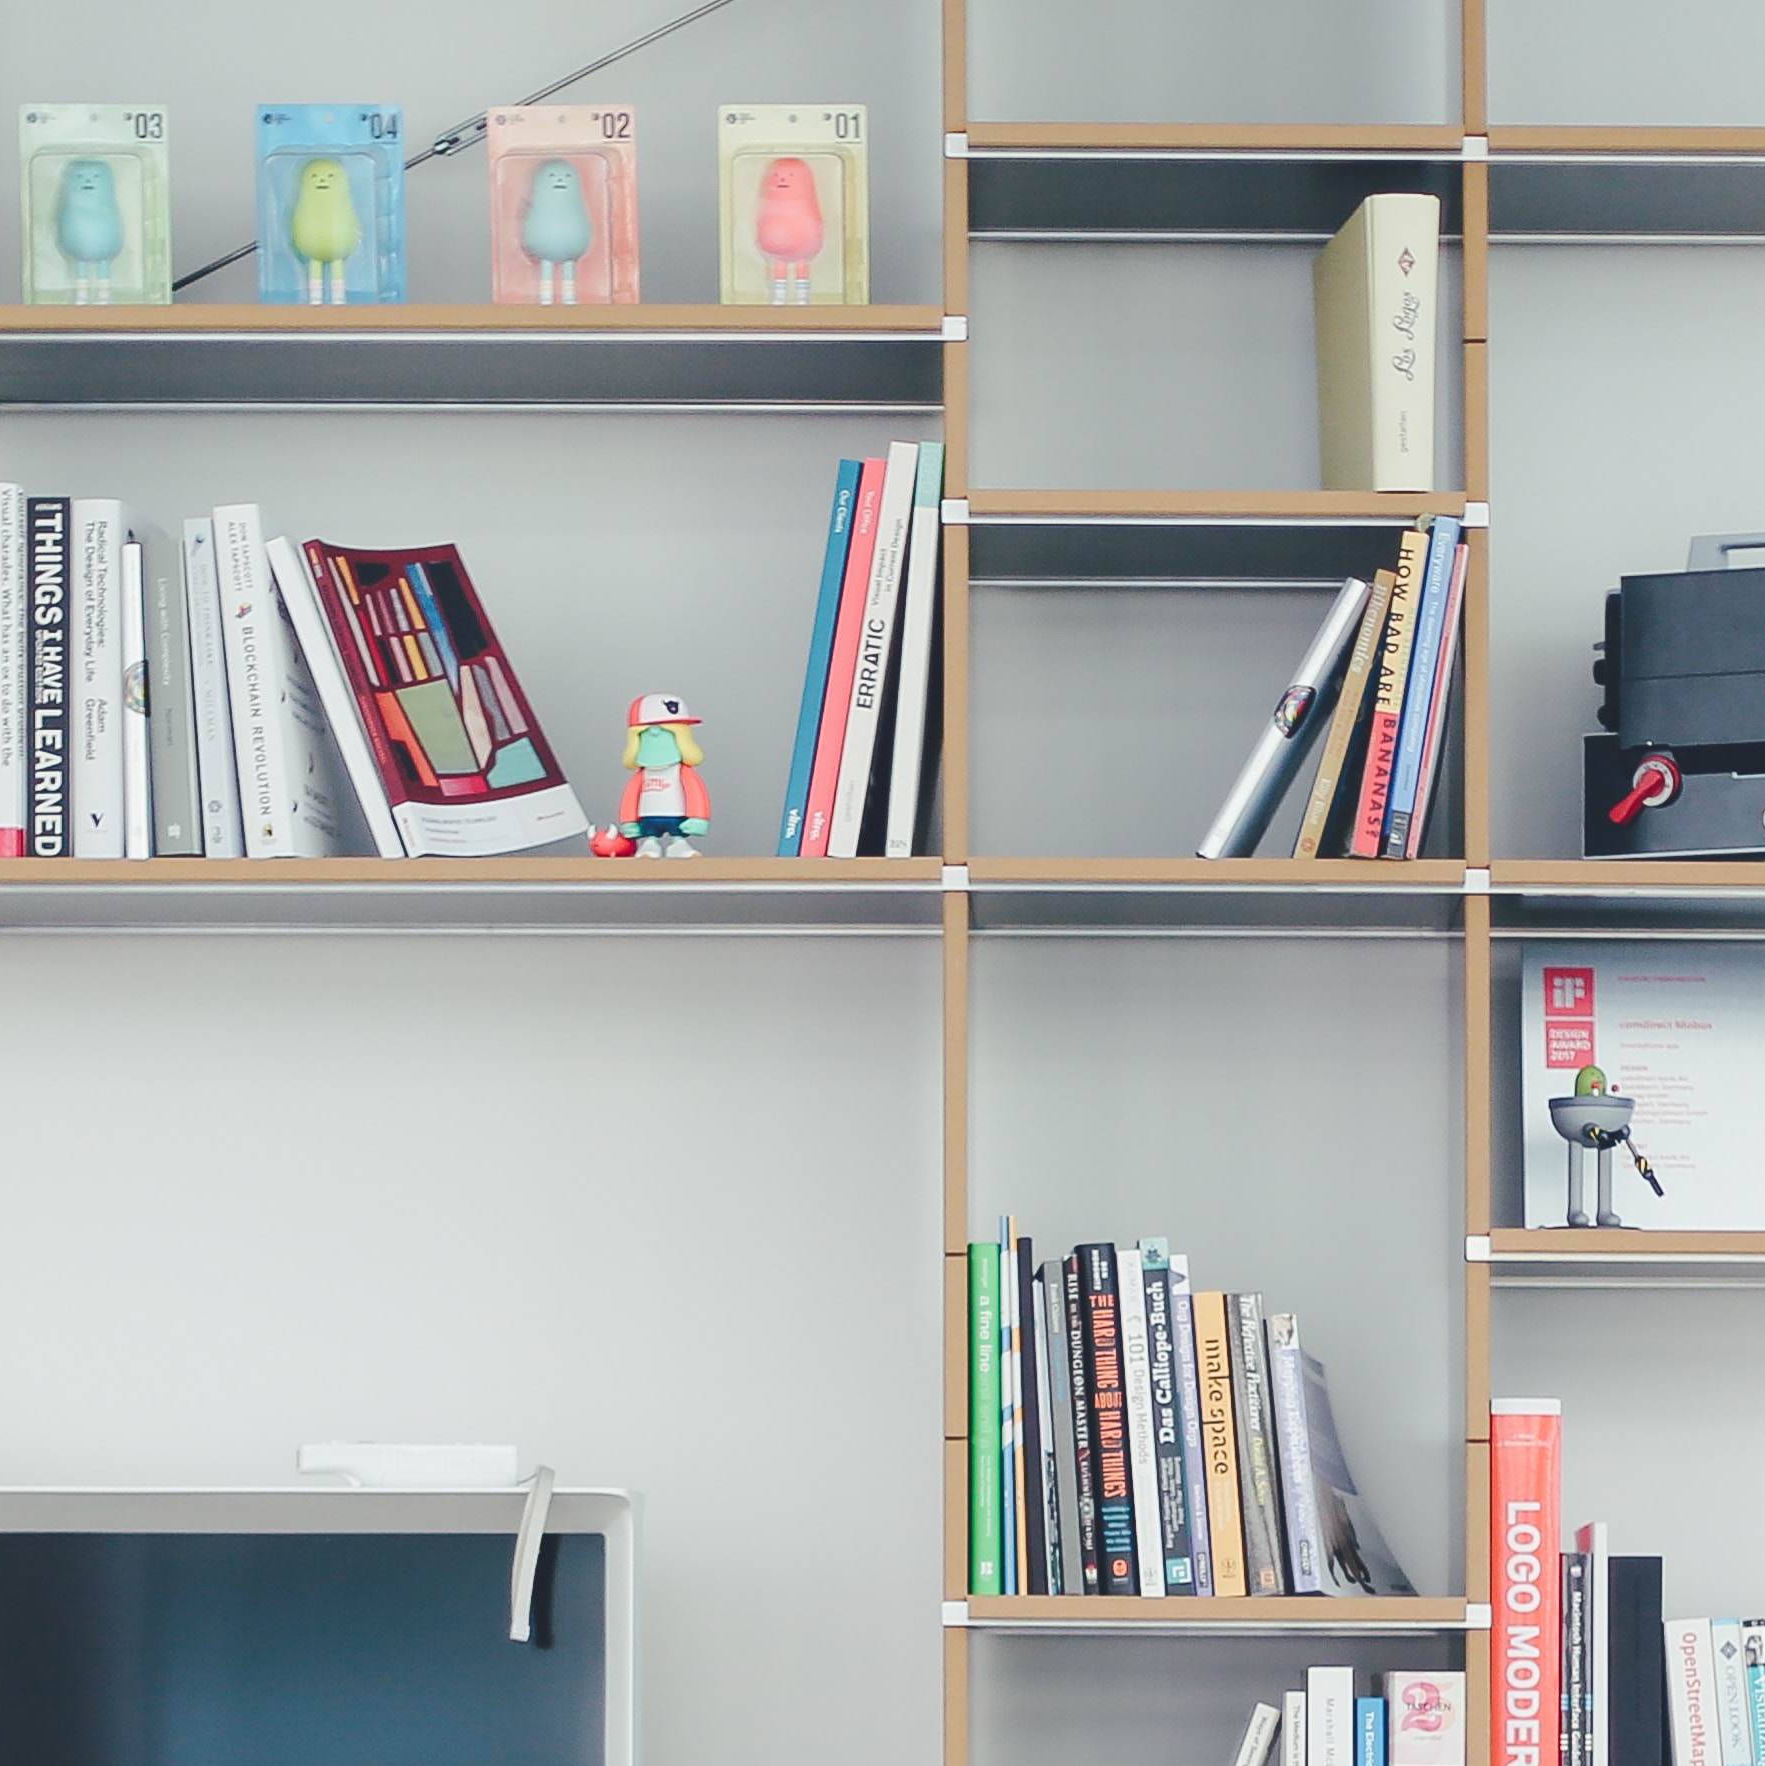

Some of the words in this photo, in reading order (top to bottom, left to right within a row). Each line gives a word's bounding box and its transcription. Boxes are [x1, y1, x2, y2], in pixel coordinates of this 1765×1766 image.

[602, 113, 631, 139] 02
[834, 113, 862, 139] 01
[86, 521, 95, 542] The
[98, 521, 107, 563] Radical
[84, 546, 95, 586] Design
[1393, 549, 1414, 602] HOW
[1429, 532, 1450, 594] Everyware
[86, 590, 95, 601] of
[96, 568, 107, 648] Technologies:
[84, 605, 95, 657] Everyday
[1385, 613, 1404, 654] BAD
[86, 661, 95, 682] Life
[856, 618, 885, 710] ERRATIC
[1377, 666, 1395, 706] ARE
[98, 699, 108, 733] Adam
[241, 626, 263, 718] BLOCKCHAIN
[252, 727, 272, 816] REVOLUTION
[1365, 718, 1397, 839] BANANAS?
[980, 1295, 989, 1306] a
[980, 1310, 992, 1341] fine
[1150, 1281, 1171, 1404] Calliope-Buch
[980, 1344, 992, 1373] line
[1159, 1409, 1174, 1444] Das
[1505, 1500, 1542, 1613] LOGO
[1364, 1711, 1375, 1731] The
